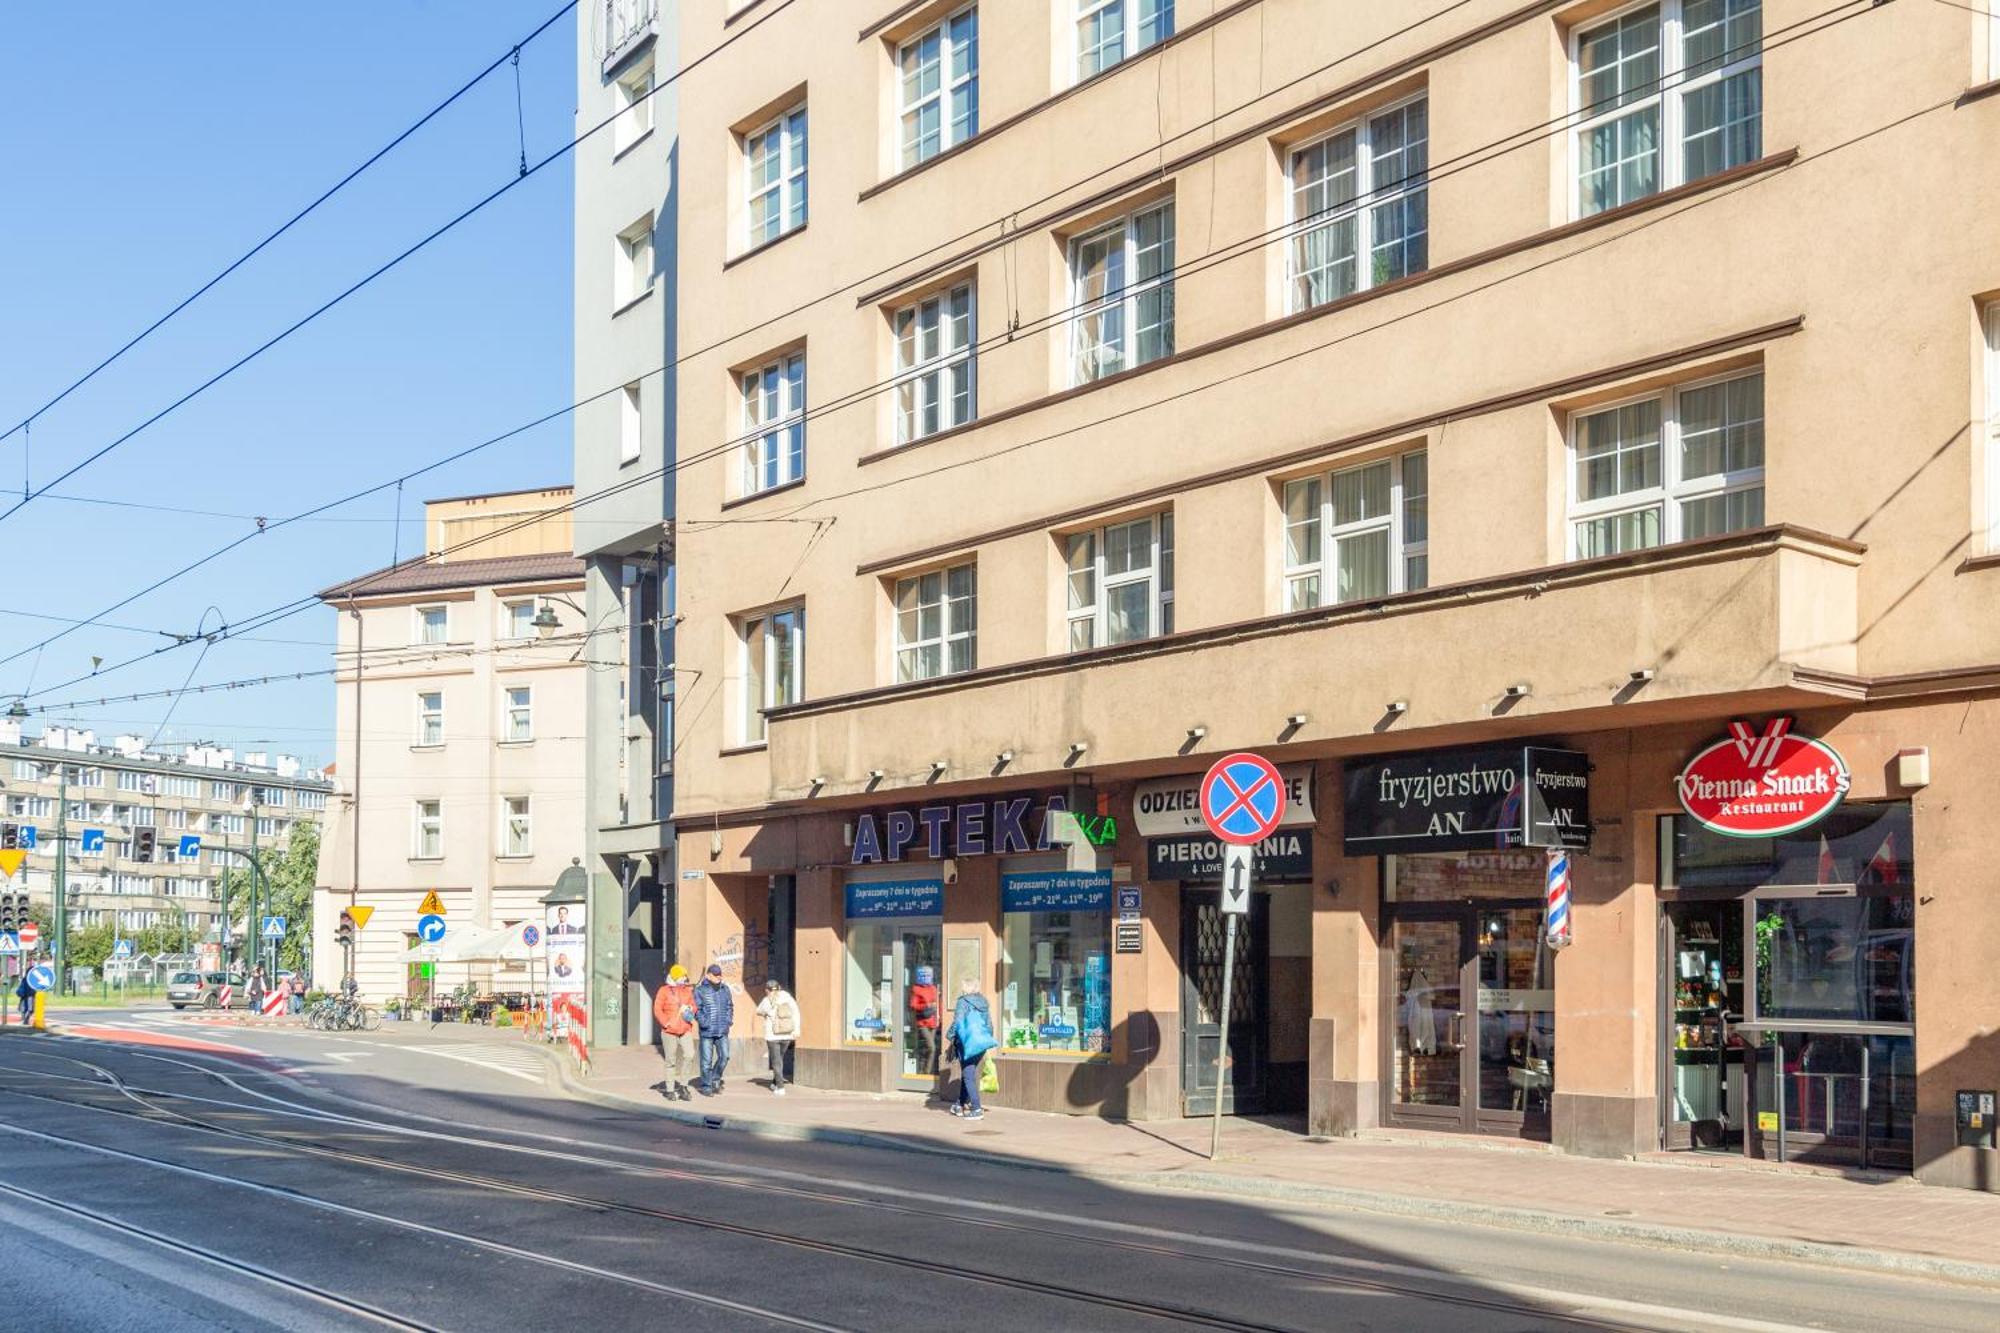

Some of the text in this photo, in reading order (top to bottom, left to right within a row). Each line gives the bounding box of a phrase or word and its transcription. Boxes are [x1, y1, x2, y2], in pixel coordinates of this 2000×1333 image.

[1379, 763, 1515, 808] fryzjerstwo
[1535, 768, 1587, 789] fryzjerstwo
[1673, 765, 1851, 800] Vienna Snack's
[1551, 808, 1573, 826] AN
[1719, 800, 1804, 816] Restaurant
[851, 796, 1068, 865] APTEKA
[1427, 812, 1465, 835] AN
[1157, 836, 1302, 863] PIERORNIA
[1202, 863, 1222, 873] LOVE
